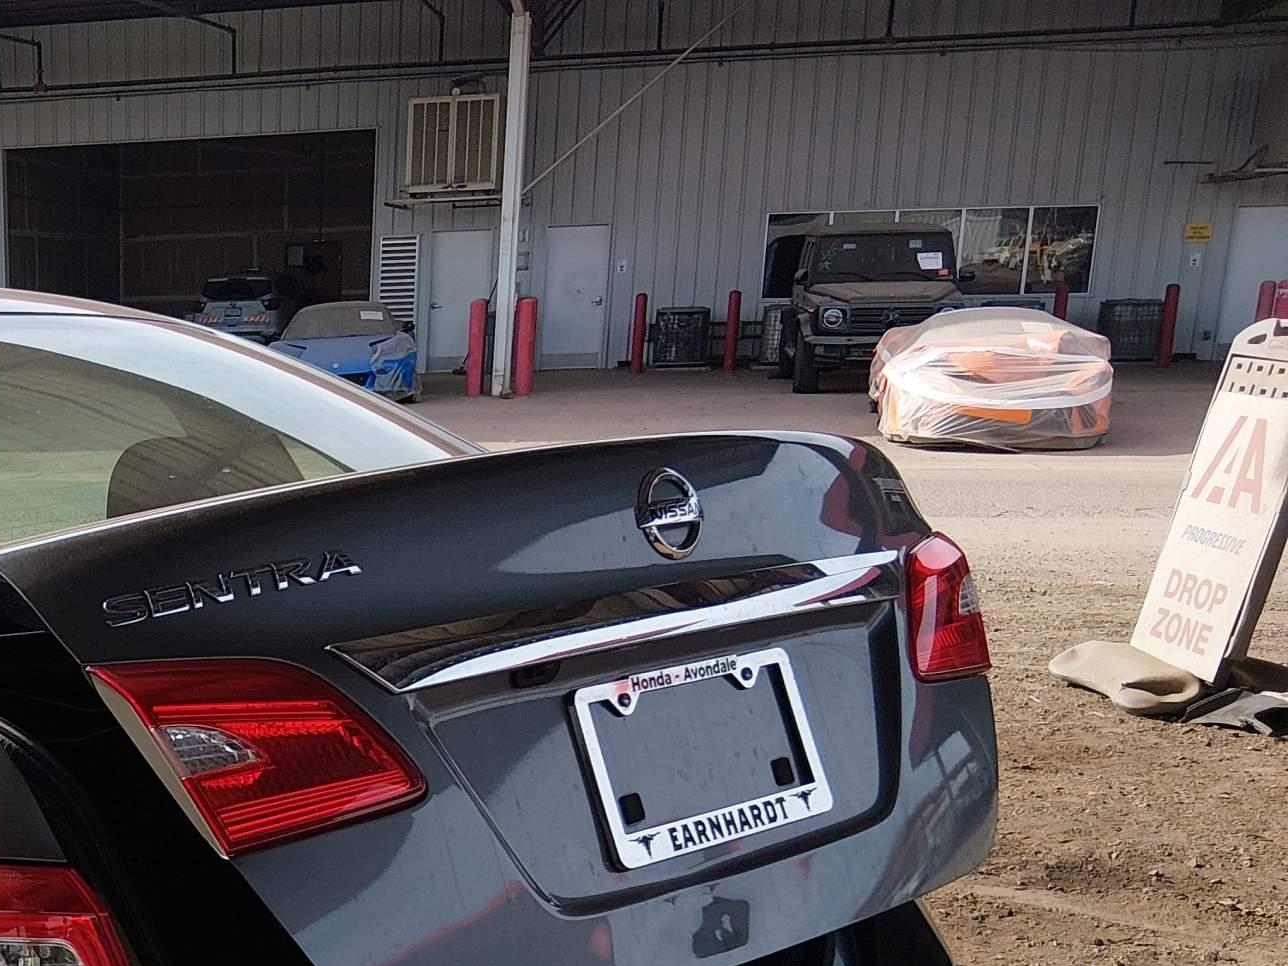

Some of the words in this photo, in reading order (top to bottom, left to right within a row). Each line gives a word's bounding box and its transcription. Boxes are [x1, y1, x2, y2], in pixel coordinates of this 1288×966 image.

[649, 502, 700, 521] NISSAN
[1181, 524, 1247, 555] PROGRESSIVE
[103, 551, 362, 627] SENTRA
[1163, 567, 1228, 614] DROP
[1149, 607, 1214, 656] ZONE
[631, 671, 672, 692] Honda
[683, 658, 737, 681] Avondale
[668, 797, 789, 852] EARNHARDT
